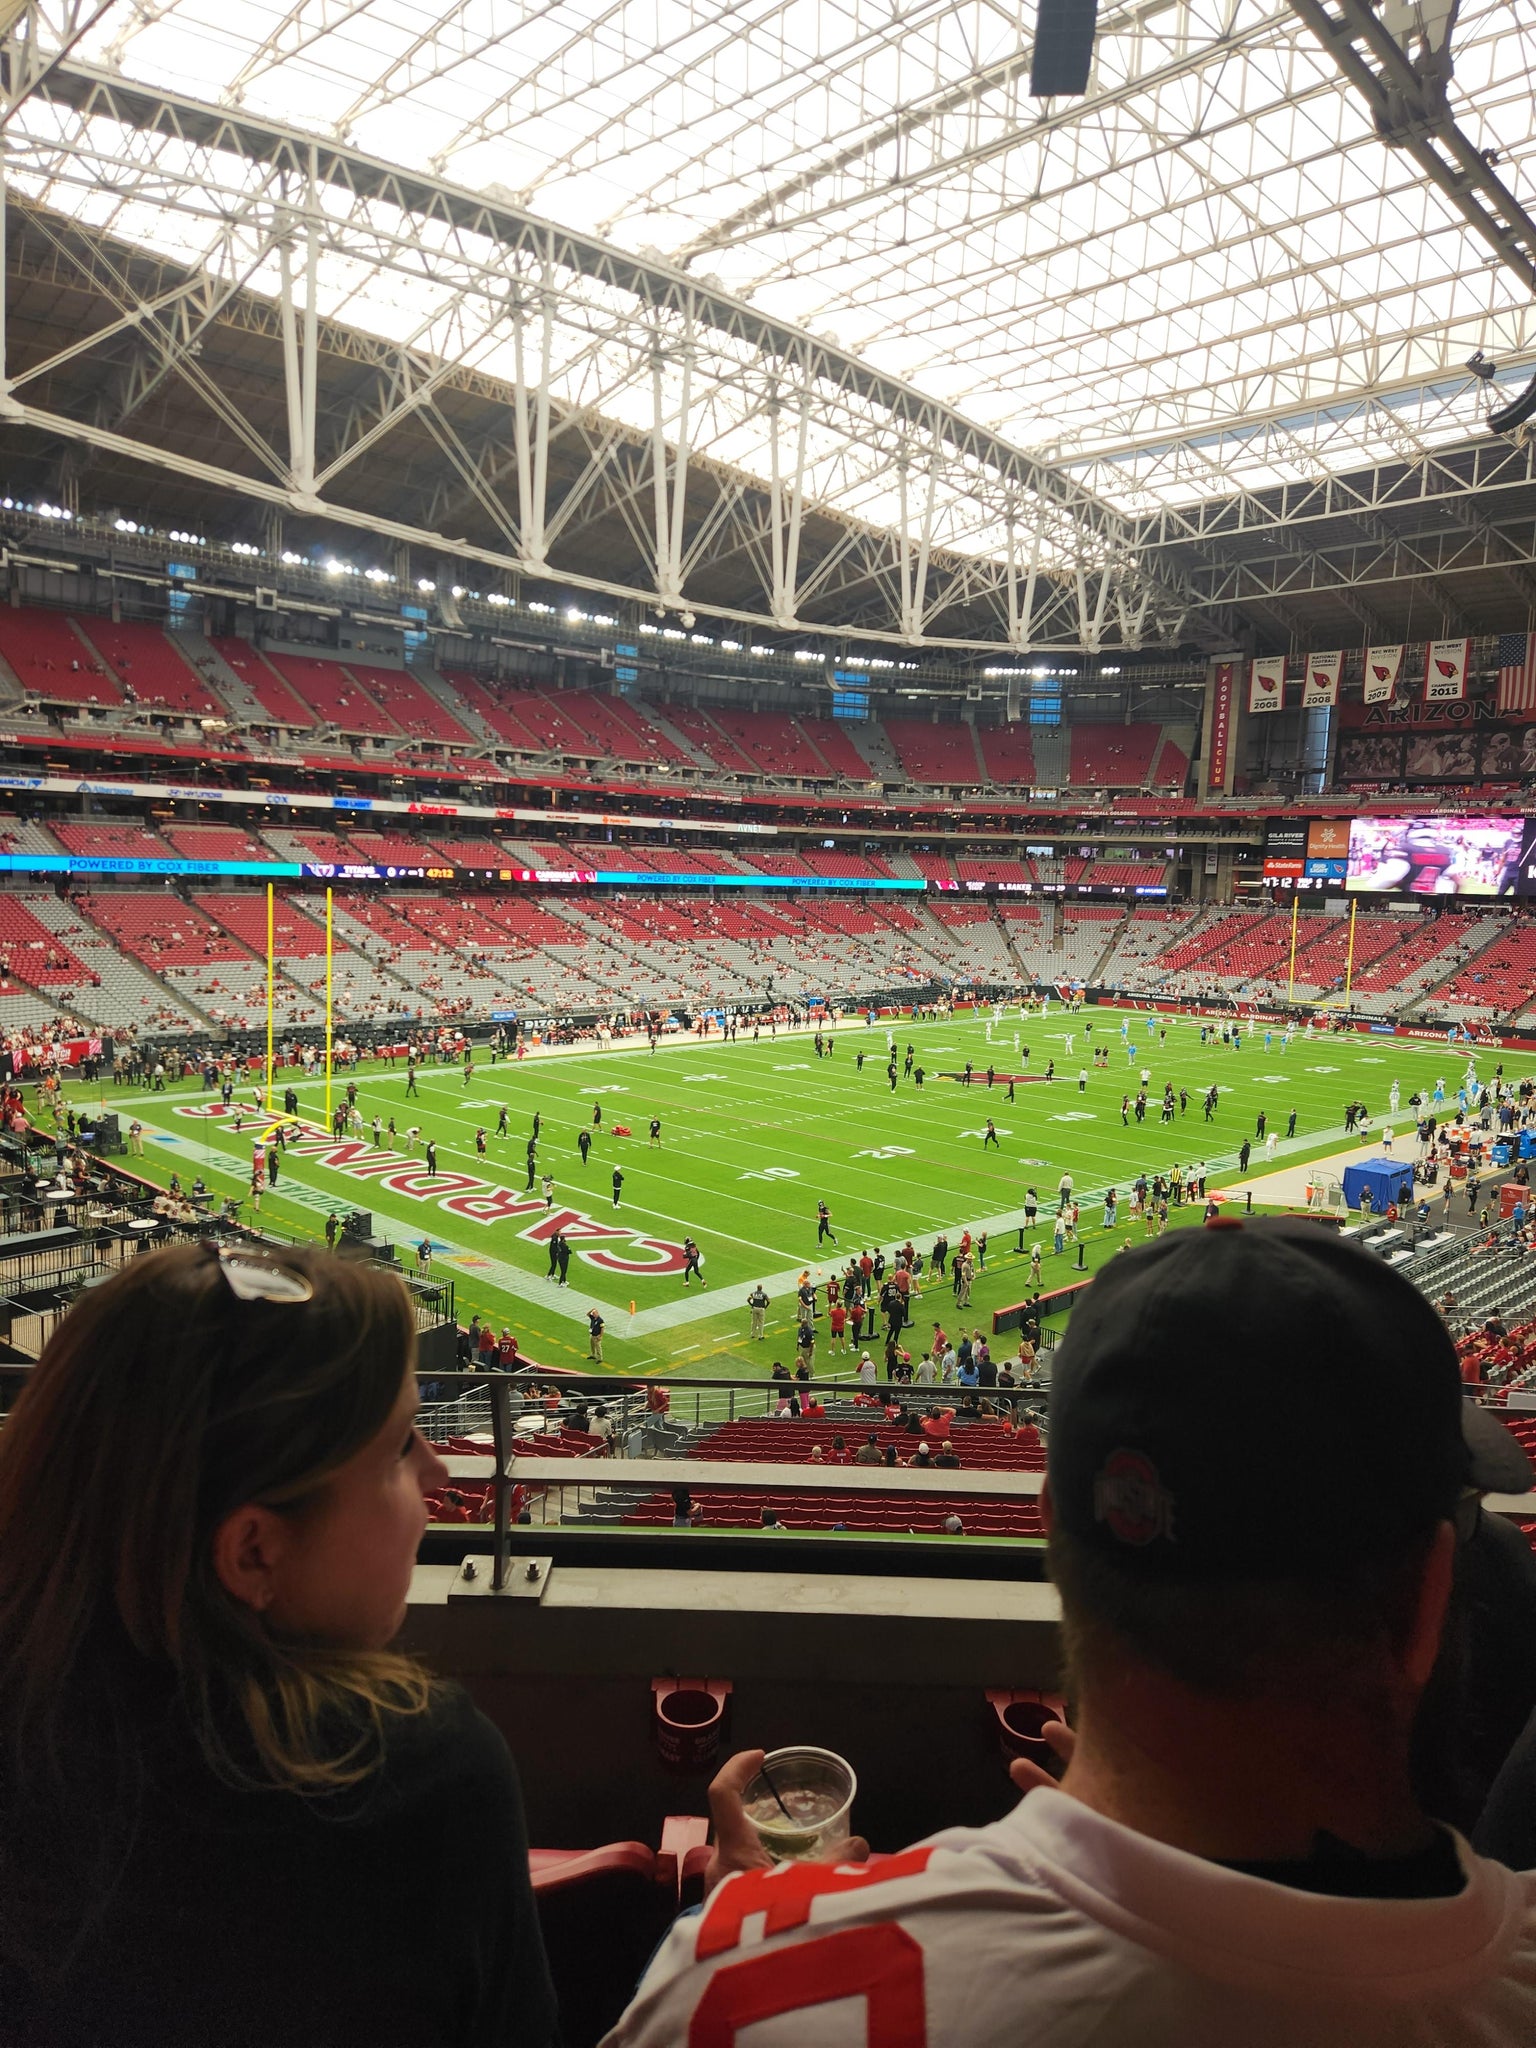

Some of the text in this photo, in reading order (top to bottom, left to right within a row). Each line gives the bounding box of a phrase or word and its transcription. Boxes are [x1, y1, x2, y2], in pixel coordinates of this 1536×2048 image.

[1367, 690, 1388, 701] 2009
[1430, 687, 1458, 697] 2015
[1306, 696, 1331, 704] 2008
[1217, 676, 1228, 747] FOOTBALL
[1363, 700, 1525, 726] ARIZONA
[1214, 749, 1223, 783] CLUB
[265, 794, 288, 804] COX
[738, 824, 762, 832] AVNET
[69, 859, 220, 872] POWERED BY COX FIBER
[343, 865, 376, 874] TITANS
[637, 874, 670, 882] POWERED
[672, 875, 681, 883] BY
[699, 876, 716, 884] FIBER
[1347, 1013, 1387, 1021] CARDINALS
[1408, 1030, 1448, 1039] ARIZONA
[856, 1145, 917, 1159] 20
[739, 1167, 801, 1181] 10
[172, 1102, 706, 1276] CARDINALS
